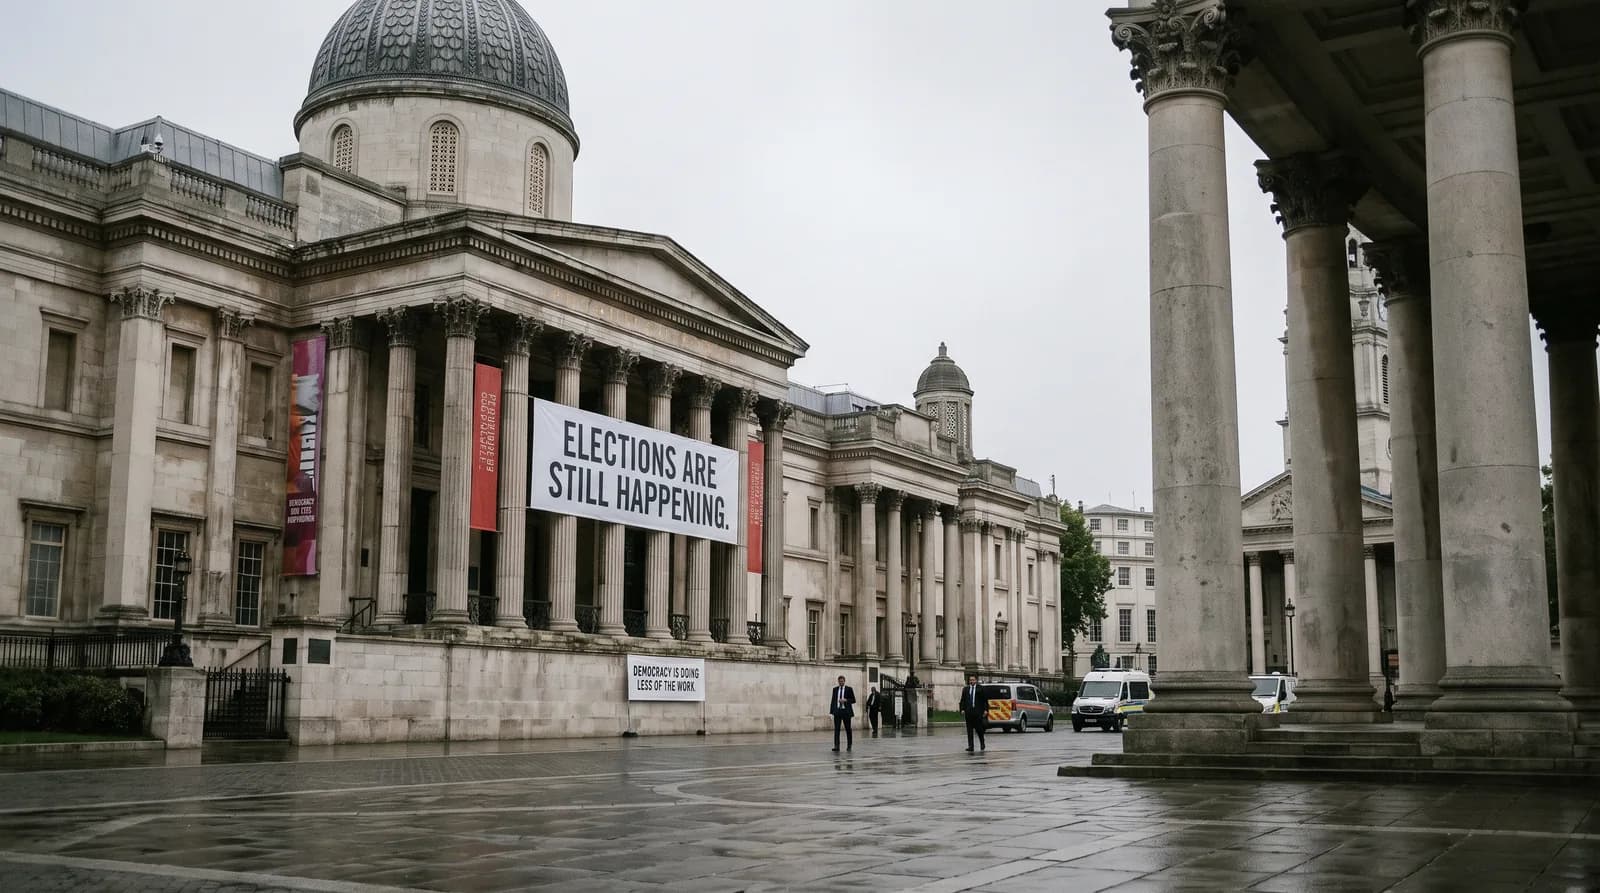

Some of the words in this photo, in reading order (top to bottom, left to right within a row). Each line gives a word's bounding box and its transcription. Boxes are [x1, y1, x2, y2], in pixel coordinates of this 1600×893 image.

[563, 419, 677, 480] ELECTIONS
[682, 450, 718, 490] ARE
[548, 461, 609, 507] STILL
[616, 474, 729, 530] HAPPENING.
[633, 665, 672, 678] DEMOCRACY
[673, 667, 680, 678] IS
[680, 667, 700, 679] DOING
[637, 680, 653, 691] LESS
[654, 680, 663, 691] OF
[664, 680, 676, 691] THE
